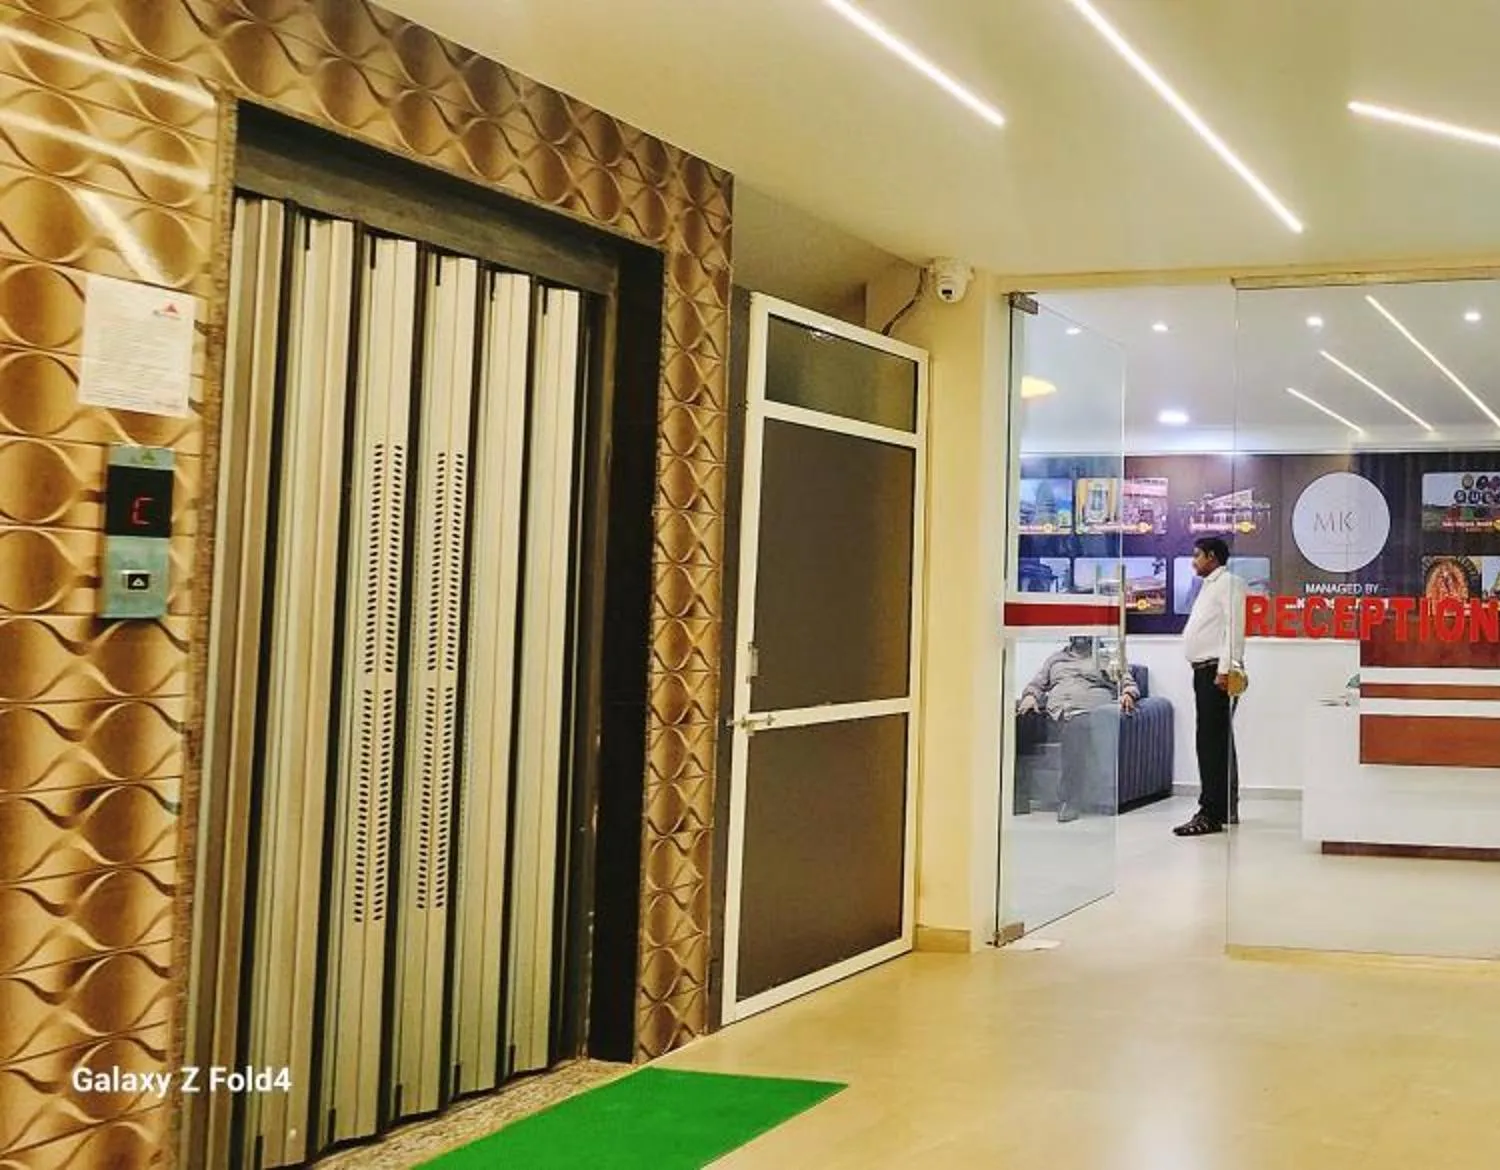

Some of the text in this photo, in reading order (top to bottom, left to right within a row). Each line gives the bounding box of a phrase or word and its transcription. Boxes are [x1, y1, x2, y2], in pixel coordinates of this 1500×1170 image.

[1305, 583, 1379, 594] MANAGED BY
[1245, 595, 1500, 642] RECEPTION
